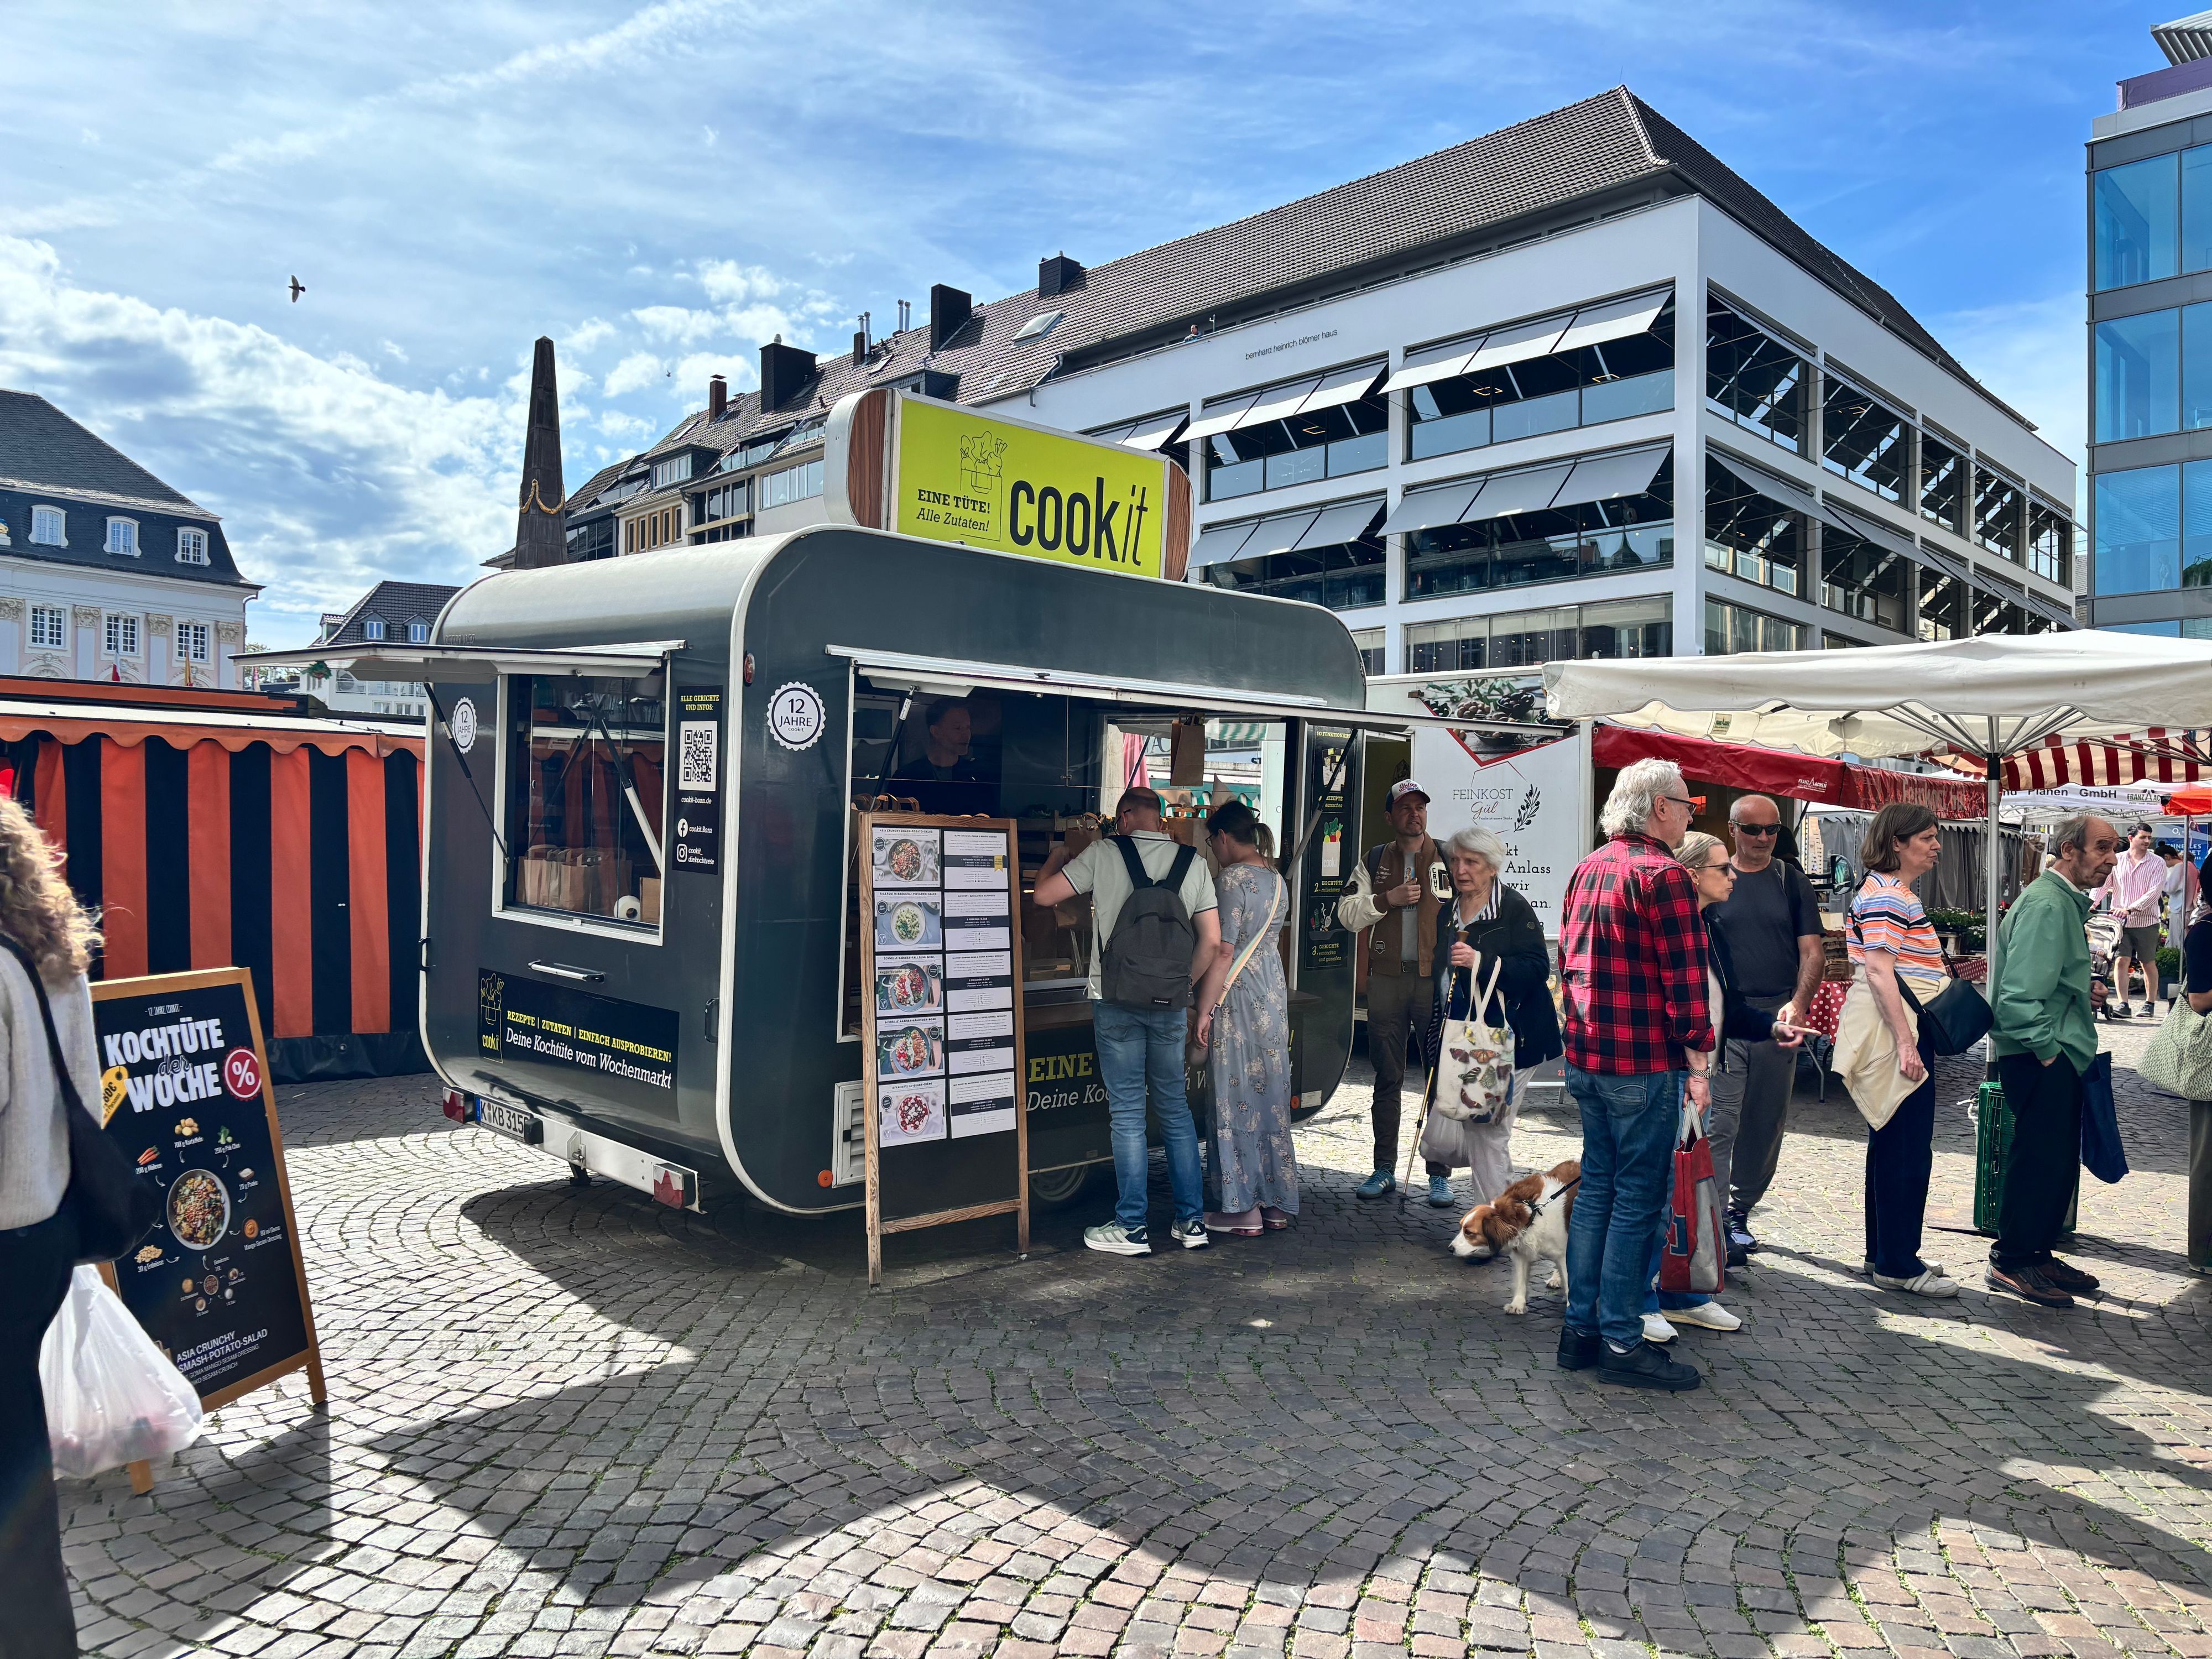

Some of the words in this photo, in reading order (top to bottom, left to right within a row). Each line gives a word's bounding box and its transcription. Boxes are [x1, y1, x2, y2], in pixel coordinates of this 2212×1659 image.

[1245, 347, 1272, 360] bernhard
[1274, 340, 1297, 353] heinrich
[1322, 329, 1338, 339] haus
[917, 489, 950, 506] EINE
[953, 495, 990, 514] TÜTE!
[916, 507, 940, 523] Alle
[943, 512, 989, 531] Zutaten!
[1010, 476, 1148, 566] cookit
[461, 711, 468, 723] 12
[788, 698, 805, 714] 12
[457, 726, 471, 735] JAHRE
[779, 716, 812, 727] JAHRE
[1453, 789, 1513, 799] FEINKOST
[2079, 789, 2117, 799] GmbH
[2146, 790, 2160, 801] AAC
[1471, 801, 1499, 820] Gül
[1505, 860, 1551, 874] Anlass
[1507, 880, 1530, 890] wir
[103, 1016, 225, 1067] KOCHTÜTE
[482, 1033, 499, 1051] cookit
[507, 1010, 535, 1026] REZEPTE
[541, 1019, 572, 1036] ZUTATEN
[578, 1029, 611, 1047] EINFACH
[611, 1037, 671, 1063] AUSPROBIEREN!
[158, 1053, 192, 1077] der
[506, 1027, 532, 1048] Deine
[534, 1035, 573, 1061] Kochtüte
[576, 1050, 596, 1067] vom
[599, 1052, 672, 1089] Wochenmarkt
[1029, 1053, 1093, 1082] EINE
[124, 1062, 222, 1113] WOCHE
[1027, 1088, 1078, 1111] Deine
[481, 1101, 487, 1121] K
[492, 1105, 504, 1126] KB
[506, 1110, 529, 1134] 315
[185, 1136, 204, 1146] Kartoffeln
[177, 1348, 196, 1363] ASIA
[196, 1330, 236, 1354] CRUNCHY
[178, 1329, 268, 1373] SMASH-POTATO-SALAD
[189, 1369, 204, 1378] GOMA
